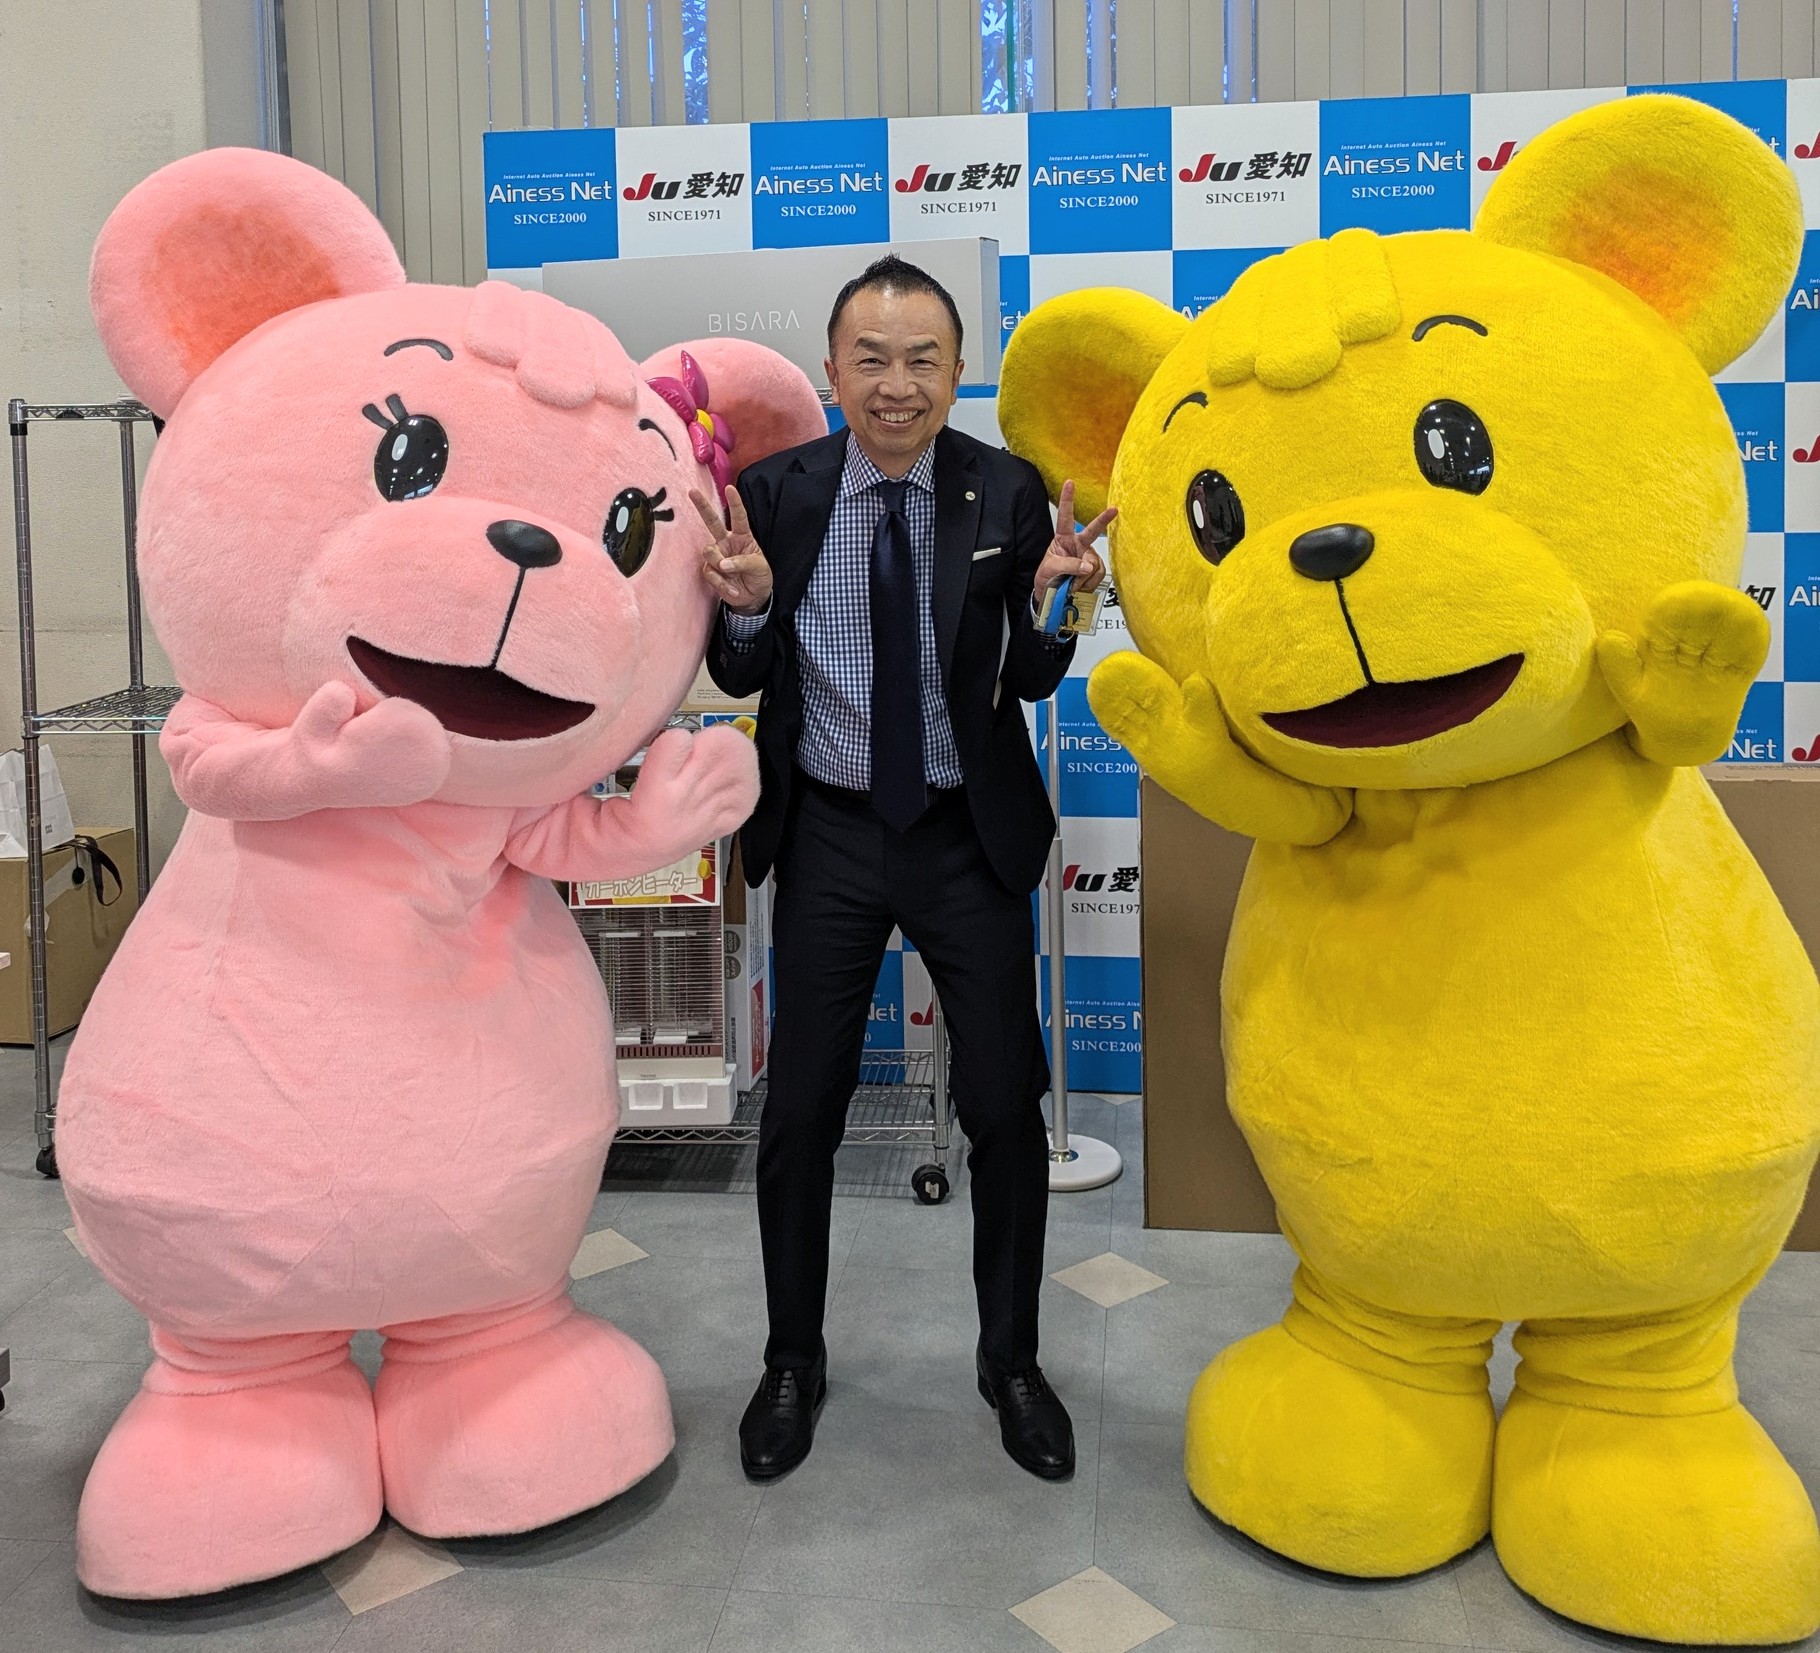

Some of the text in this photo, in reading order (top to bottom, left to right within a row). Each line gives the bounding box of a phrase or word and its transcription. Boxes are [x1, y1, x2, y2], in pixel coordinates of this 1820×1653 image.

[1323, 149, 1465, 176] Ainess Net
[1032, 161, 1167, 187] Ainess Net
[754, 171, 883, 195] Ainess Net
[488, 180, 613, 203] Ainess Net
[1205, 191, 1286, 205] SINCE1971
[1351, 184, 1435, 199] SINCE2000
[920, 201, 997, 215] SINCE1971
[1059, 195, 1139, 209] SINCE2000
[648, 209, 721, 222] SINCE1971
[780, 204, 857, 217] SINCE2000
[514, 212, 587, 225] SINCE2000
[708, 309, 800, 333] BISARA
[1000, 310, 1025, 330] et
[1728, 738, 1777, 759] Net
[1067, 763, 1138, 774] SINCE200
[1071, 903, 1140, 914] SINCE197
[1072, 1040, 1141, 1052] SINCE200
